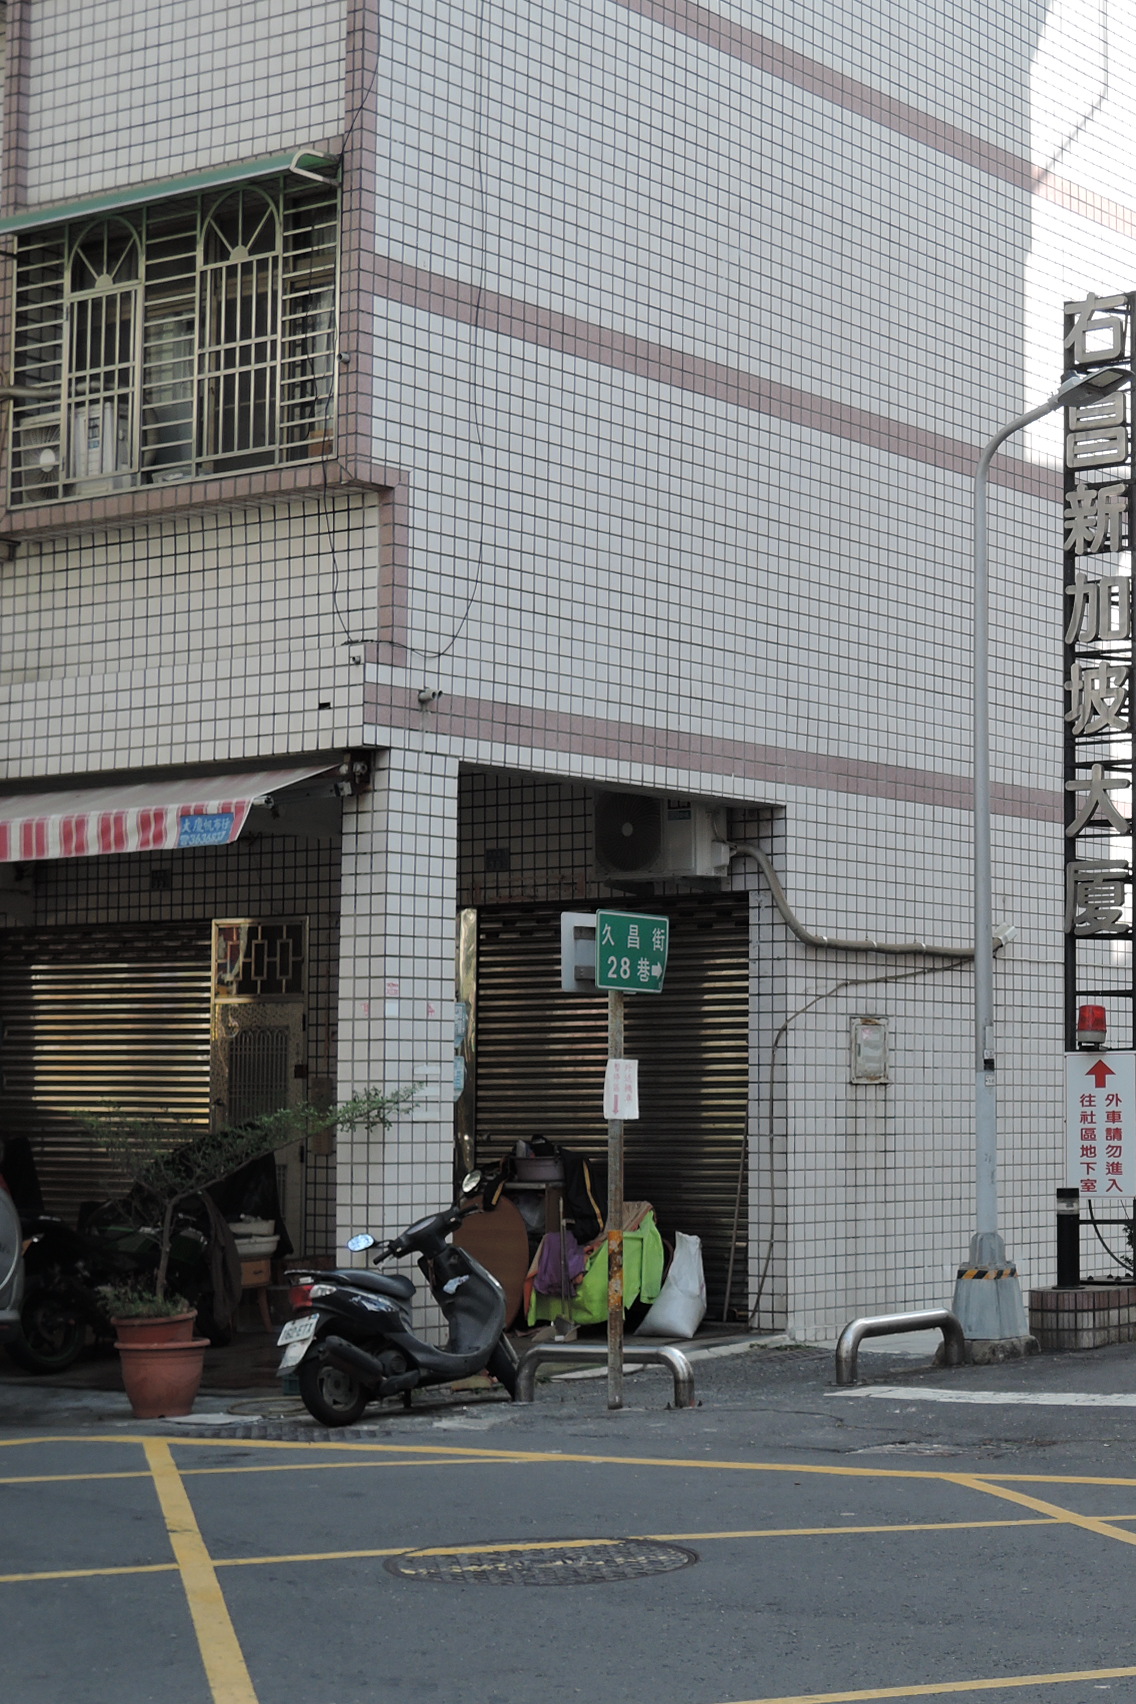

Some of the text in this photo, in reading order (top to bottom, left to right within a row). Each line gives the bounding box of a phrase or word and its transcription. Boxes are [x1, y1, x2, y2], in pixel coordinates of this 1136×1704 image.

[1065, 292, 1130, 935] 右昌新加坡大廈
[601, 923, 666, 952] 久昌街
[607, 955, 651, 982] 28巷
[1079, 1093, 1097, 1193] 往社區地下室
[1105, 1093, 1123, 1193] 外車請勿進入
